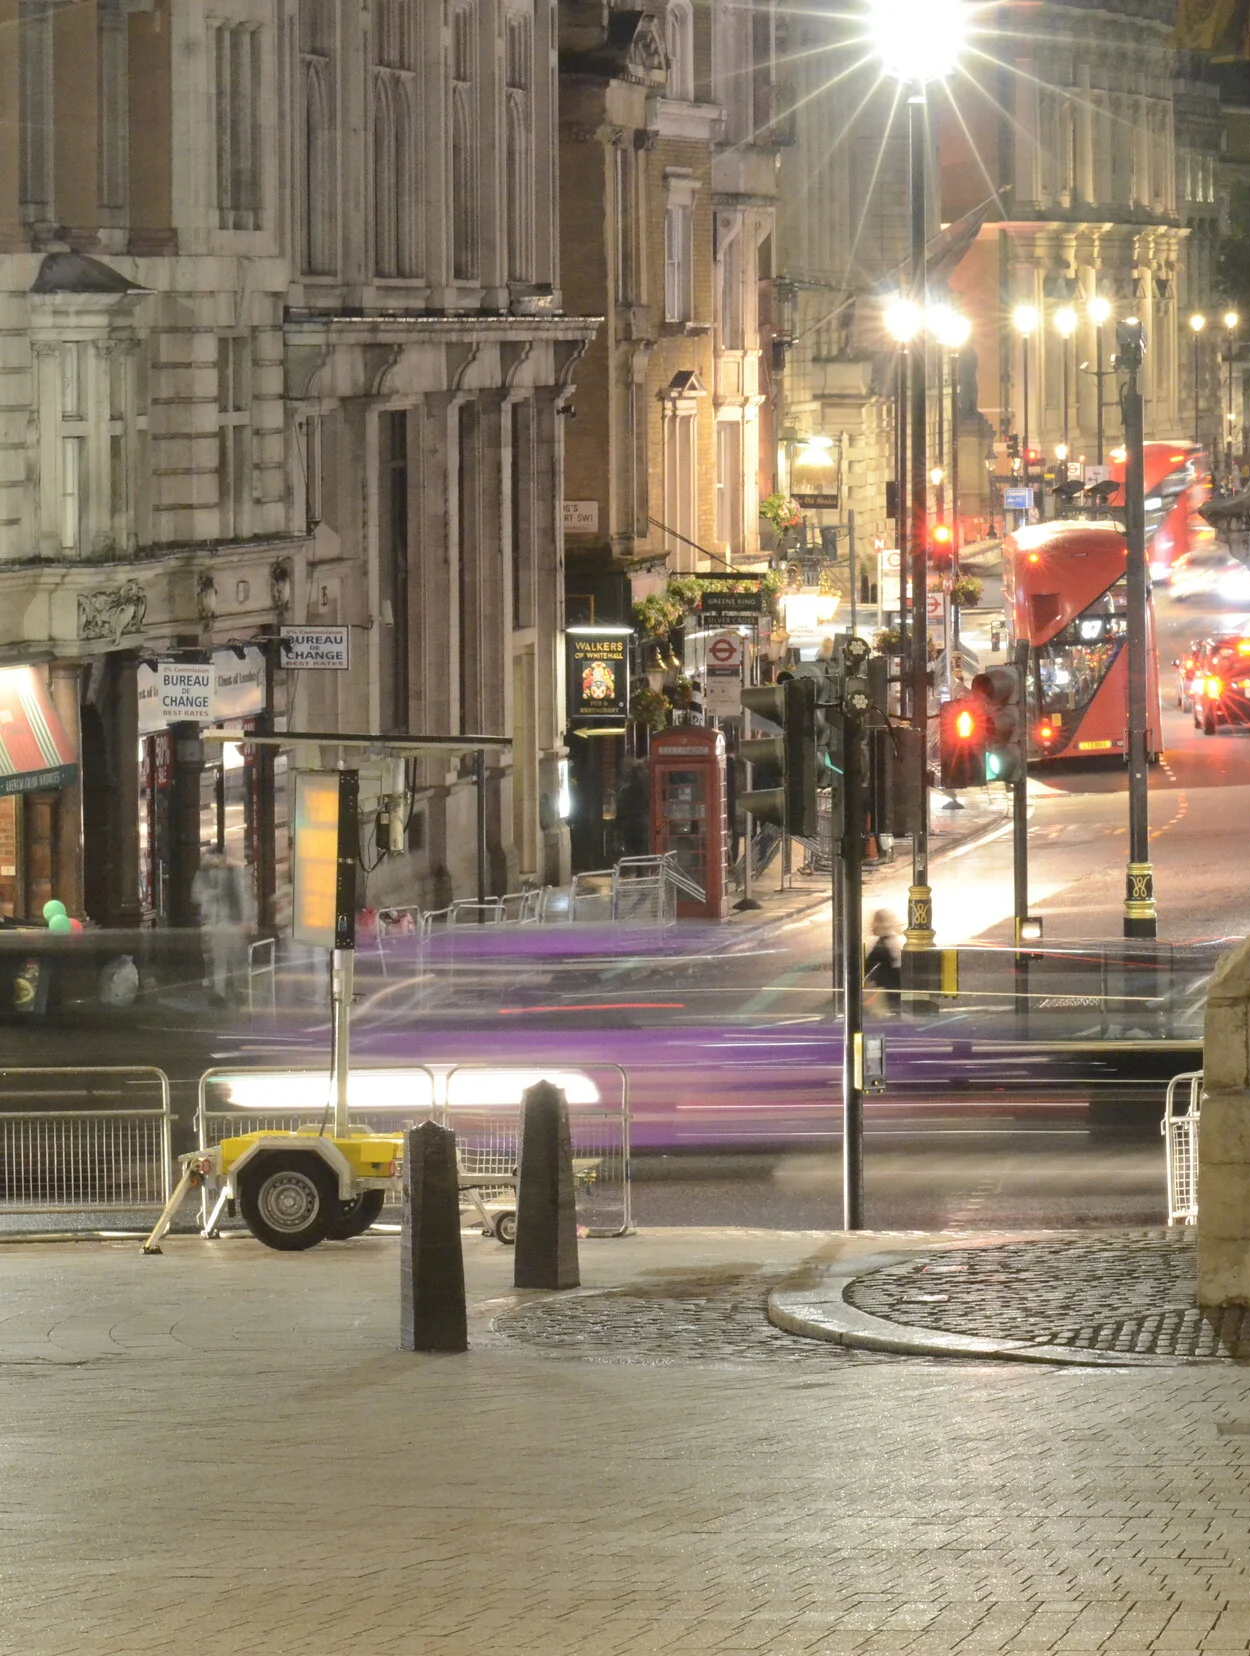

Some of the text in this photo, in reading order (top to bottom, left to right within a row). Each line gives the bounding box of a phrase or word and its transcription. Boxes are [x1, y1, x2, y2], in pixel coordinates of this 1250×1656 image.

[874, 539, 885, 549] N
[288, 636, 343, 645] BUREAU
[575, 642, 623, 651] WALKERS
[286, 651, 344, 660] CHANGE
[163, 675, 209, 686] BUREAU
[163, 695, 209, 707] CHANGE
